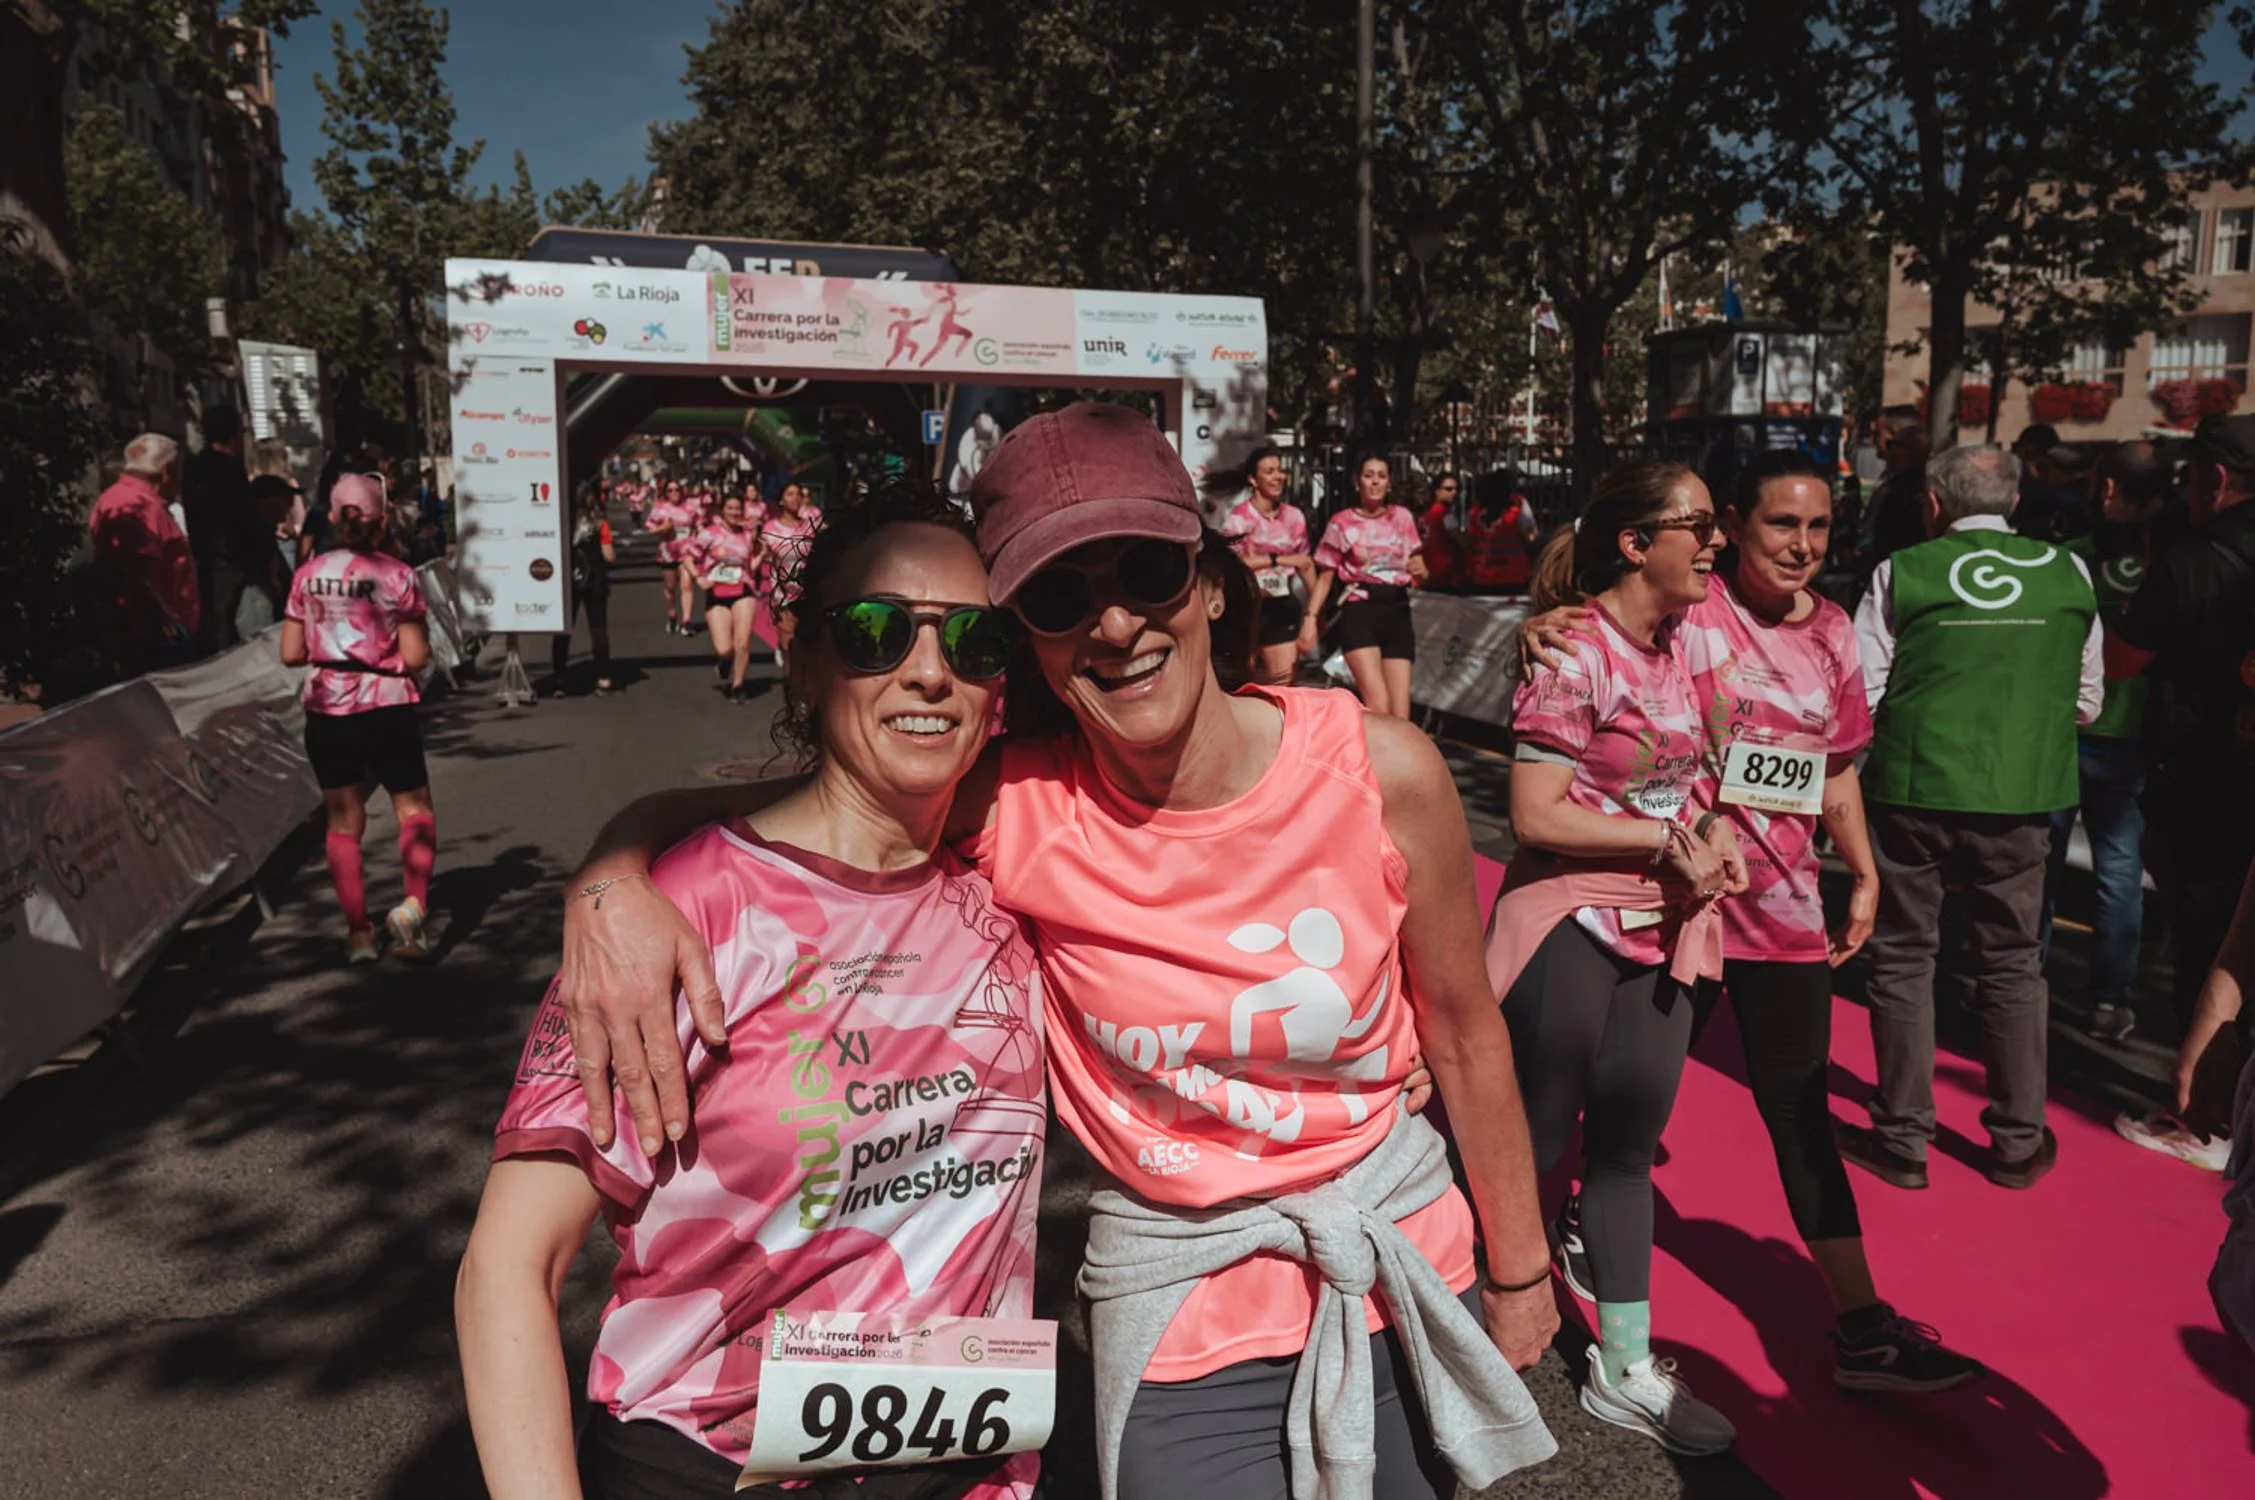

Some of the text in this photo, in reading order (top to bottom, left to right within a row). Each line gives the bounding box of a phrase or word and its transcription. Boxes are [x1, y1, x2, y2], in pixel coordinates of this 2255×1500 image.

[616, 285, 680, 304] La Rioja
[733, 288, 754, 305] XI
[733, 309, 840, 327] Carrera por la
[734, 327, 838, 344] investigación
[929, 416, 944, 440] P
[1735, 697, 1753, 716] XI
[1743, 753, 1813, 791] 8299
[831, 1030, 870, 1067] XI
[1084, 1012, 1206, 1072] HOY
[844, 1069, 978, 1116] Carrera
[778, 1030, 850, 1229] mujer
[850, 1118, 946, 1181] por la
[1138, 1142, 1199, 1168] AECC
[787, 1324, 804, 1340] XI
[808, 1329, 859, 1343] Carrera
[862, 1333, 885, 1345] por
[785, 1343, 876, 1360] investigación
[799, 1382, 1010, 1462] 9846
